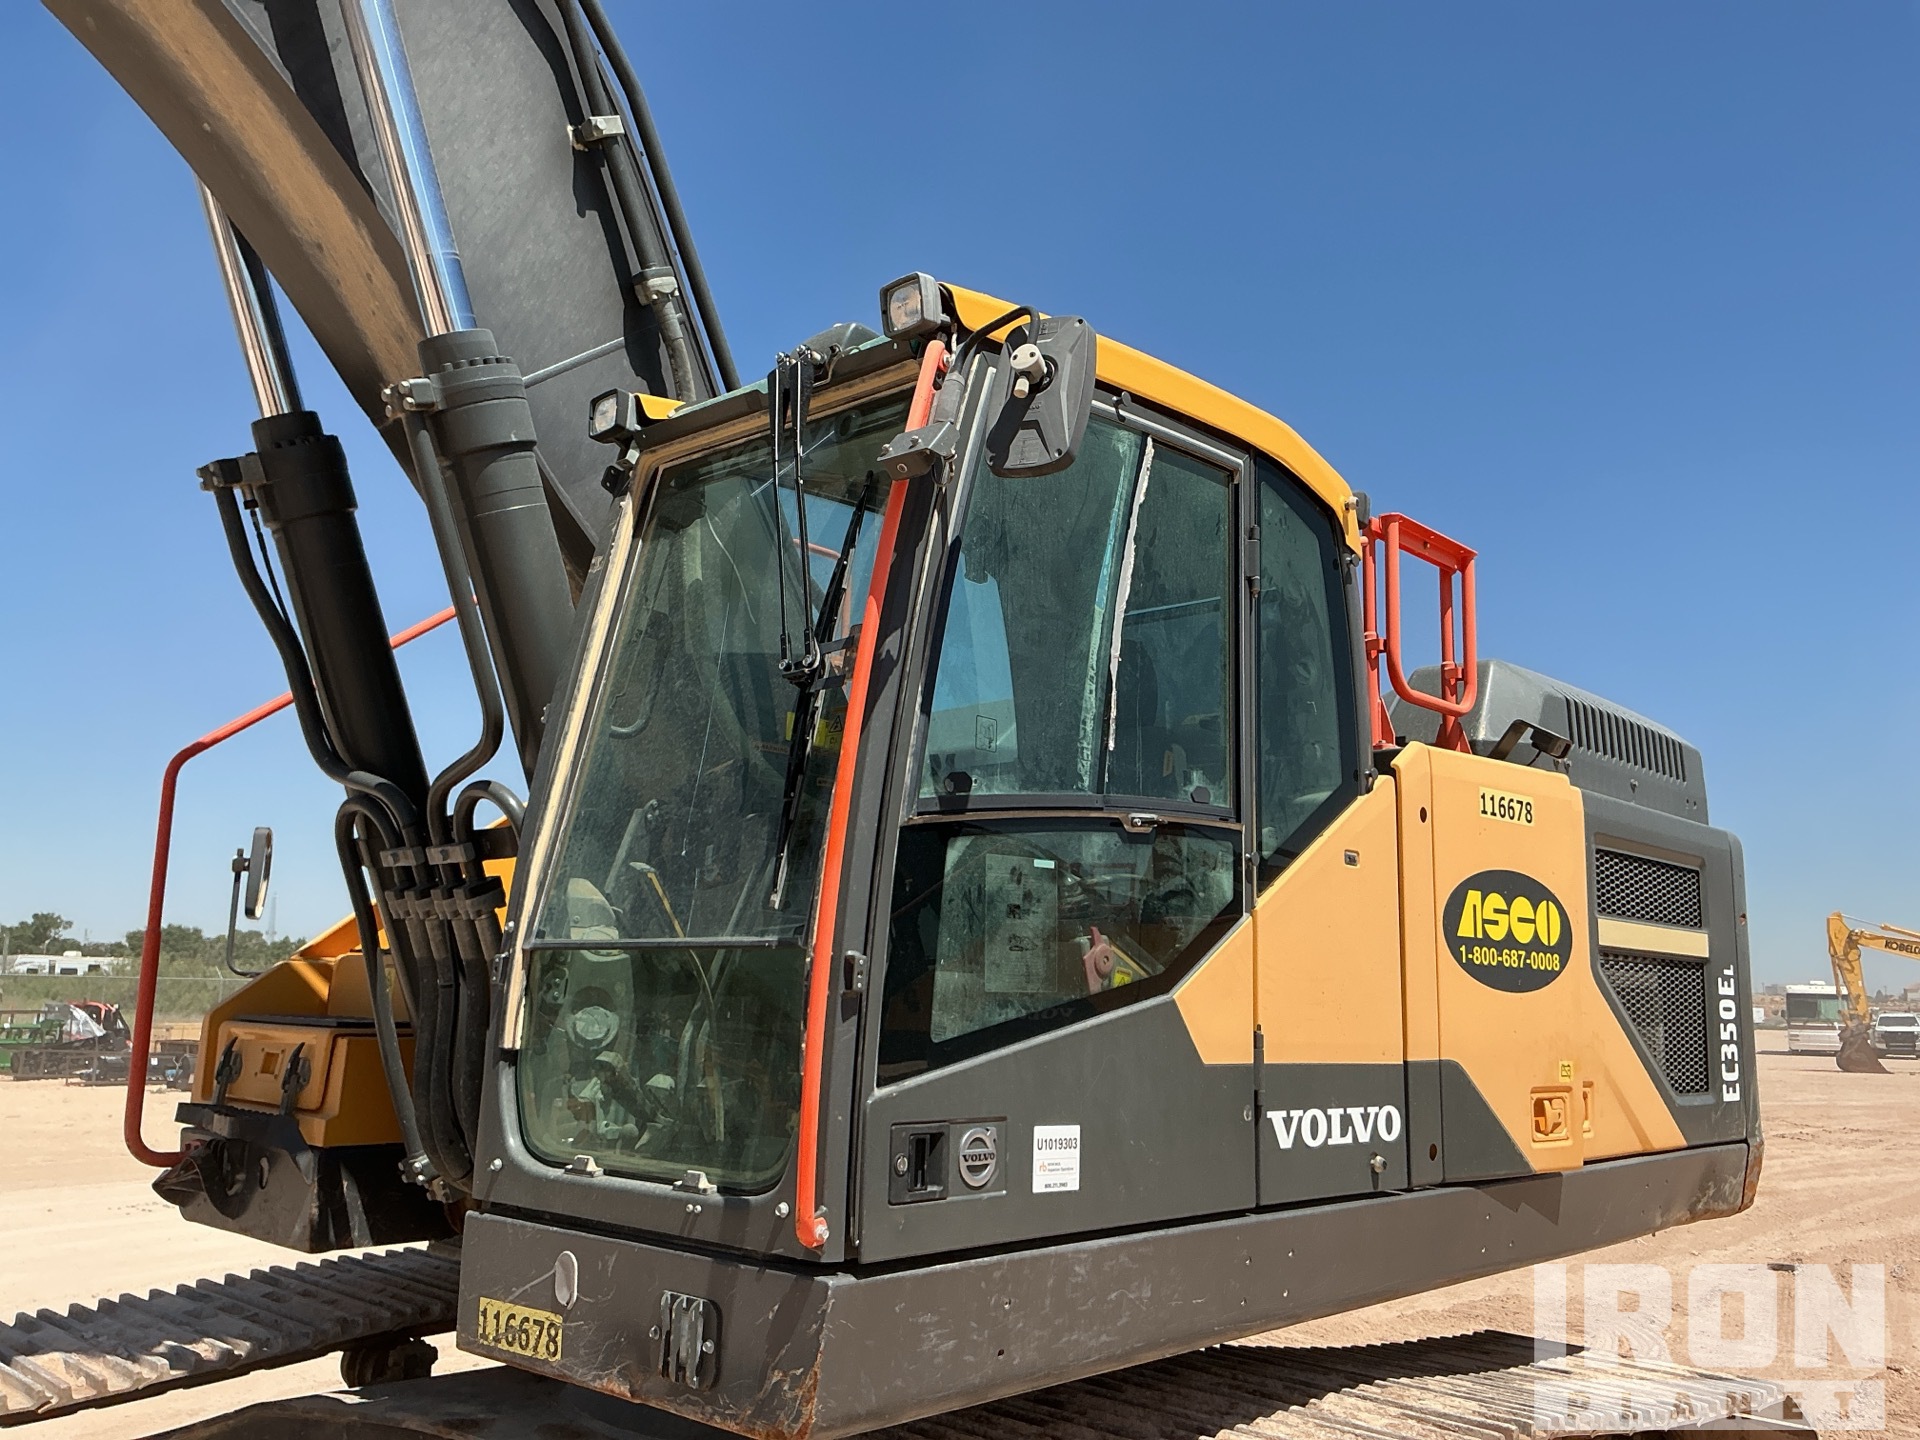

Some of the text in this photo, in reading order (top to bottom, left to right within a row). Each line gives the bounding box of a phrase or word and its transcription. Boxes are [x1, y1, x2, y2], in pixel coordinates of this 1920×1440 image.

[1480, 792, 1533, 824] 116678
[1457, 889, 1561, 947] ASCO
[1459, 945, 1560, 971] 1-800-687-0008
[1266, 1104, 1401, 1149] VOLVO
[962, 1152, 995, 1163] VOLVO
[1037, 1137, 1078, 1151] U1019303
[479, 1307, 561, 1358] 116678
